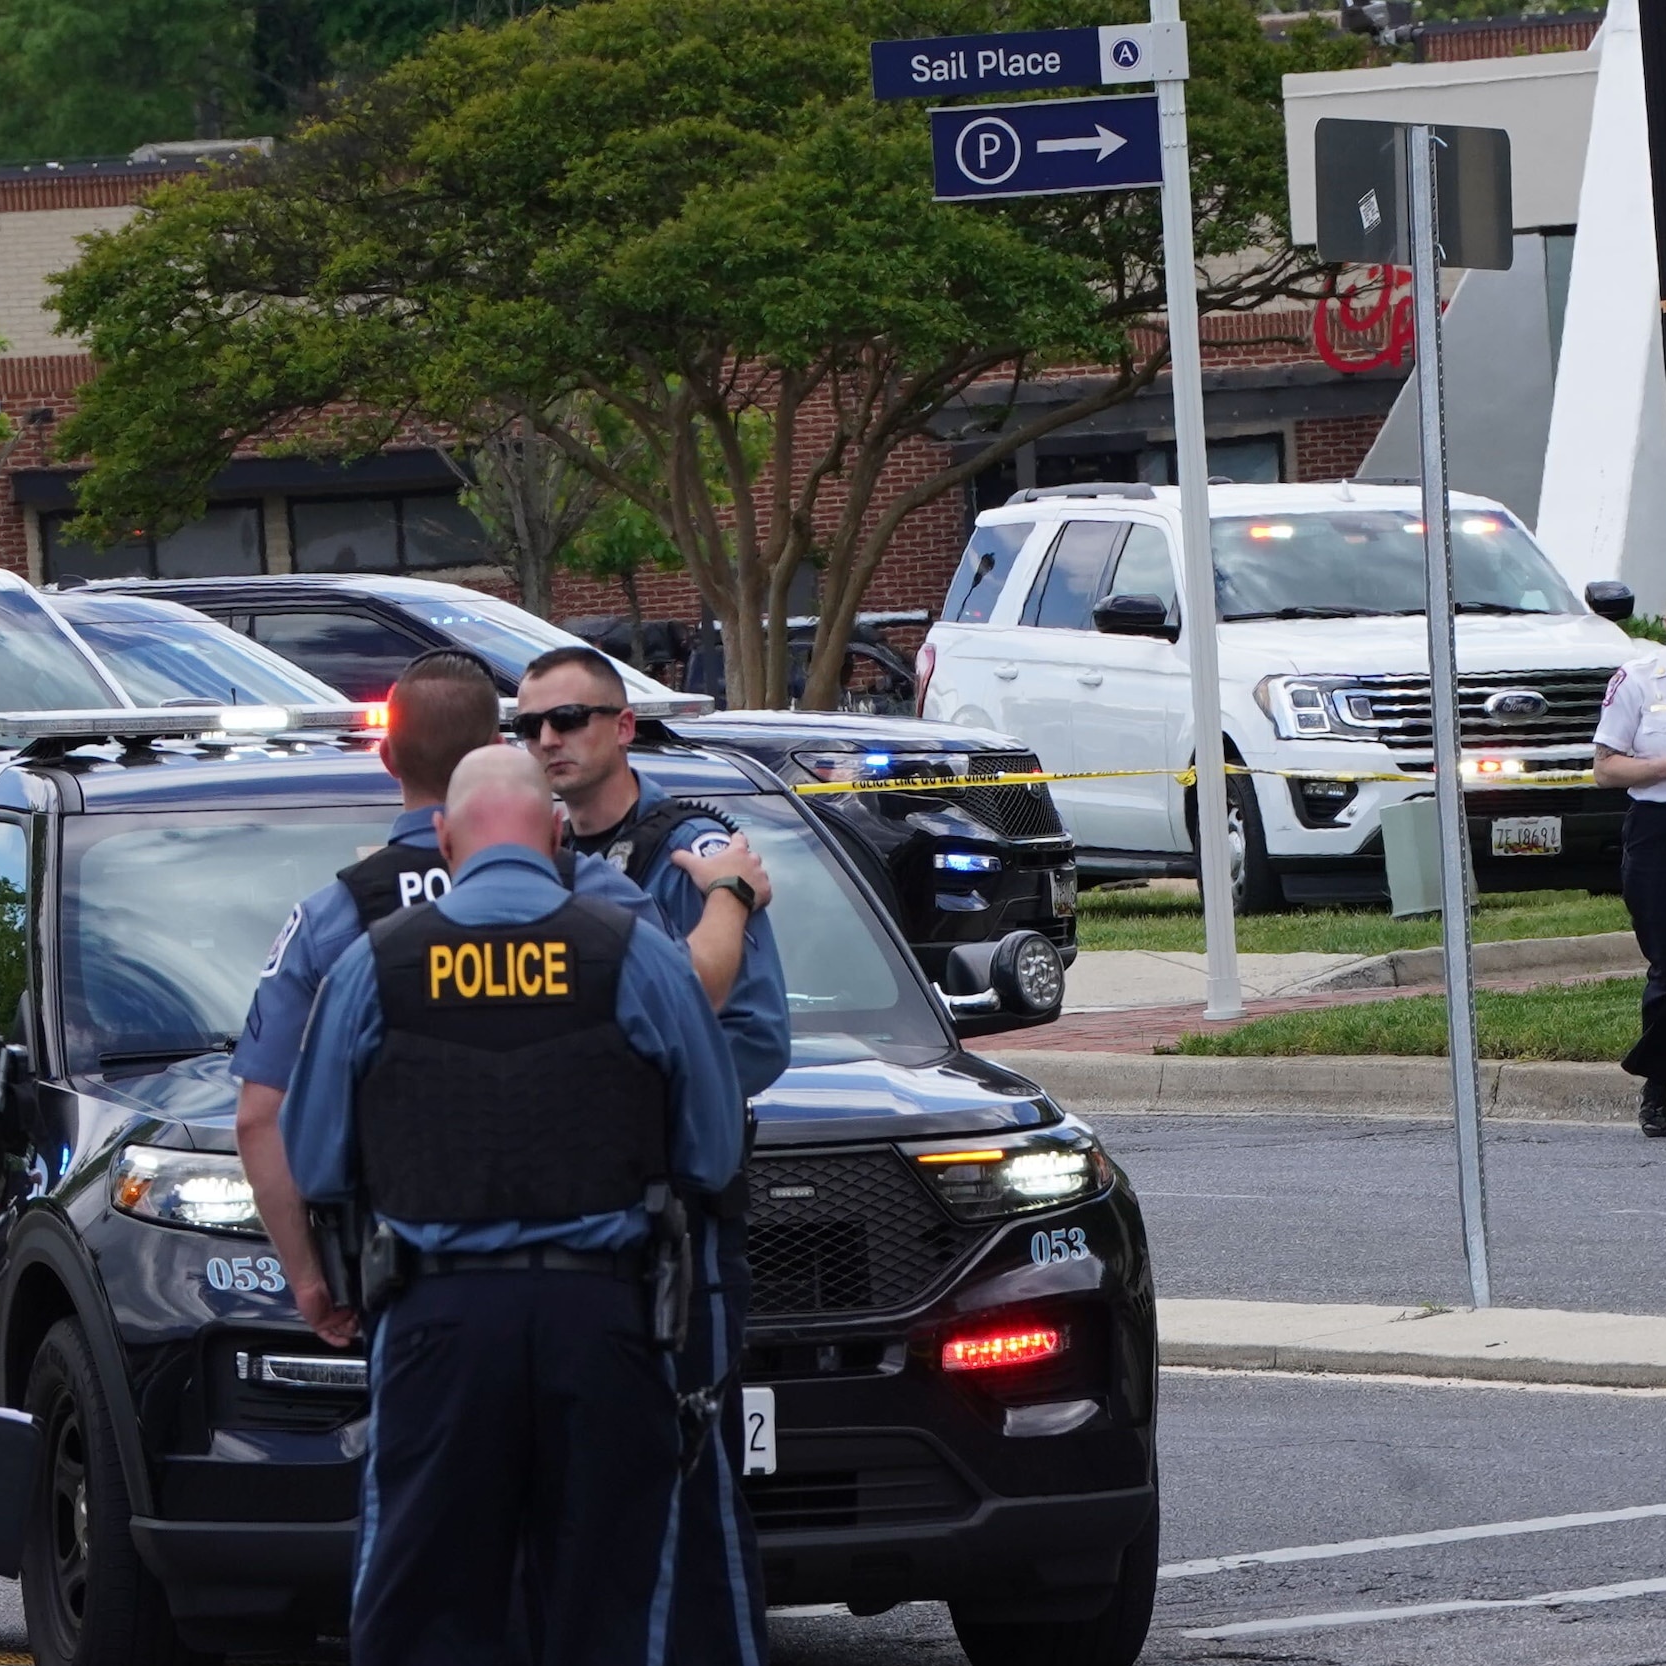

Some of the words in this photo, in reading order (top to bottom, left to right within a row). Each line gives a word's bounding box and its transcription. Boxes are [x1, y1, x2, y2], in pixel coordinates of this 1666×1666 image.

[910, 51, 968, 83] Sail
[977, 48, 1062, 79] Place
[1118, 43, 1134, 63] A
[977, 132, 1002, 170] P
[429, 941, 569, 1000] POLICE
[1030, 1226, 1091, 1267] 053
[206, 1256, 286, 1293] 053
